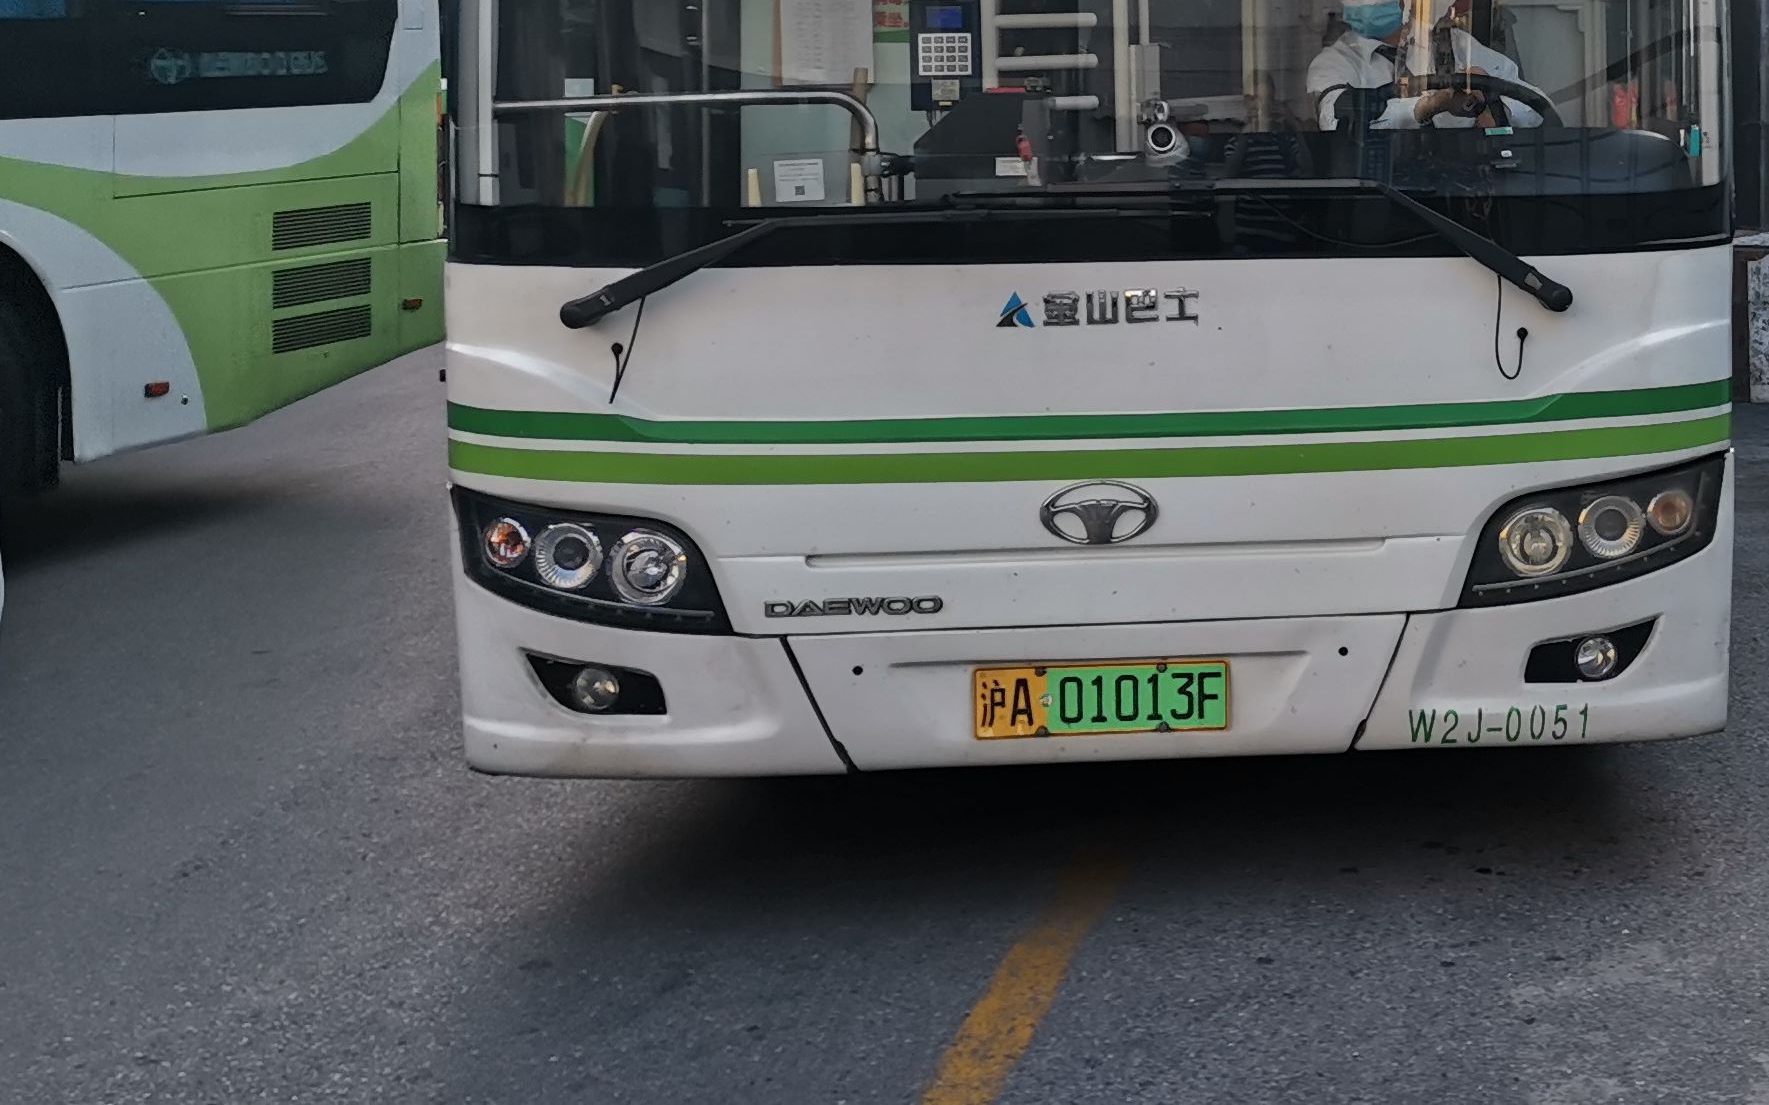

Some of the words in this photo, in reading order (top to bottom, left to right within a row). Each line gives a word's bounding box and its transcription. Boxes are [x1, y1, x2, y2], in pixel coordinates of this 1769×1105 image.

[1042, 286, 1200, 326] 金山巴士
[764, 595, 944, 618] DAEWOO
[1408, 702, 1589, 743] W2J-0051
